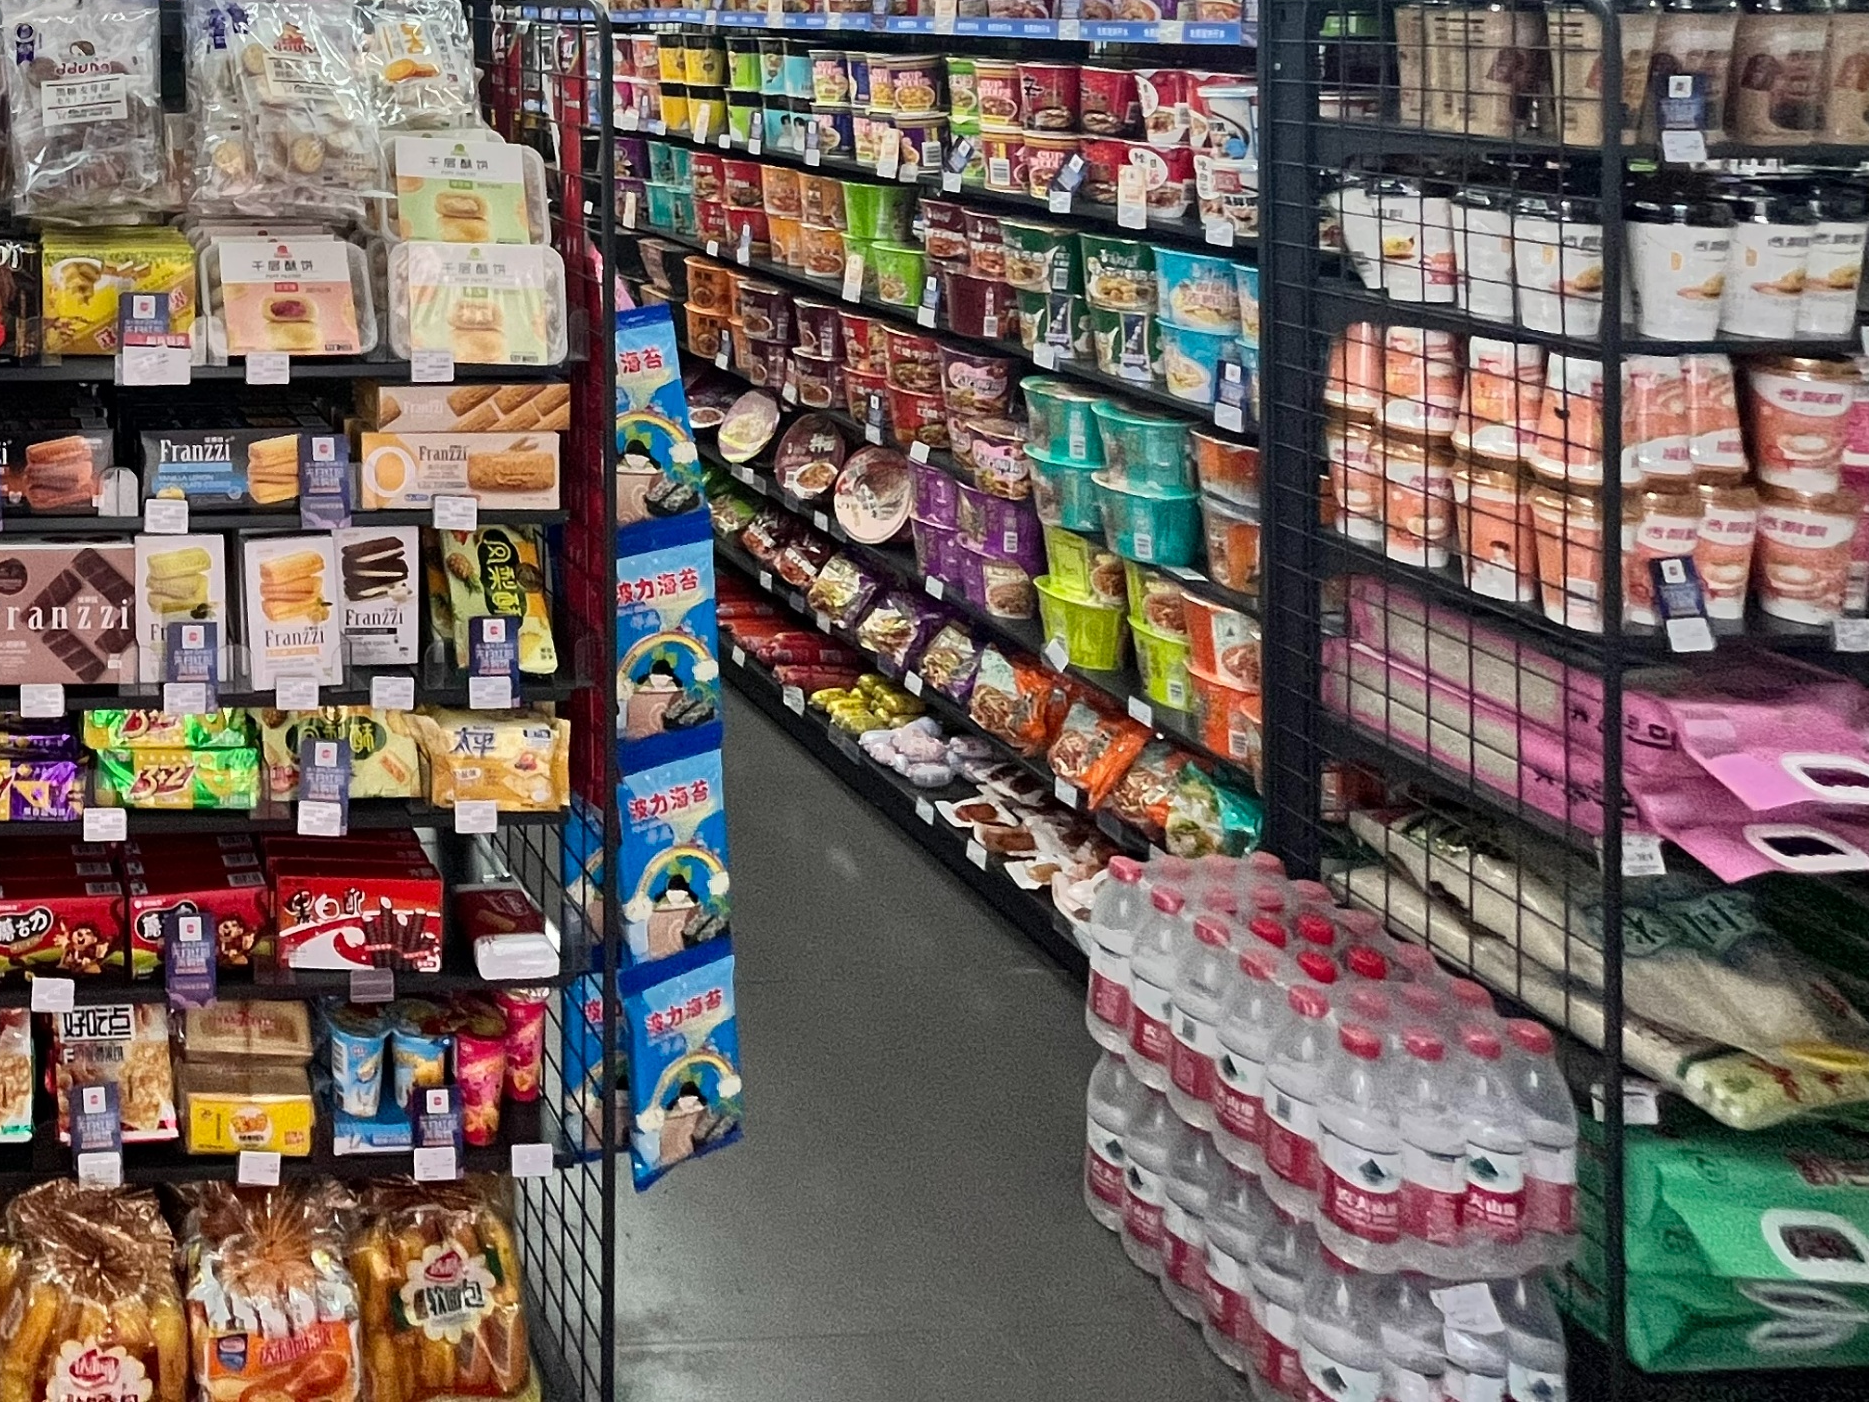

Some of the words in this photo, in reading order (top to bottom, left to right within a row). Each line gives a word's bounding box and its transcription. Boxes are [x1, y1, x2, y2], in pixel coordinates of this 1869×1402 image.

[55, 58, 112, 76] ddung
[426, 155, 490, 171] 千层酥饼
[252, 259, 315, 273] 千层酥饼
[621, 348, 664, 374] 海苔
[160, 438, 231, 463] Franzzi
[419, 445, 468, 462] Franzzi
[617, 568, 699, 605] 波力海苔
[344, 608, 403, 626] Franzzi
[265, 629, 325, 648] Franzzi
[454, 728, 496, 754] 太平
[143, 761, 189, 791] 3+2
[627, 780, 709, 821] 波力海苔
[645, 989, 723, 1034] 波力海苔
[63, 1011, 132, 1040] 好吃点
